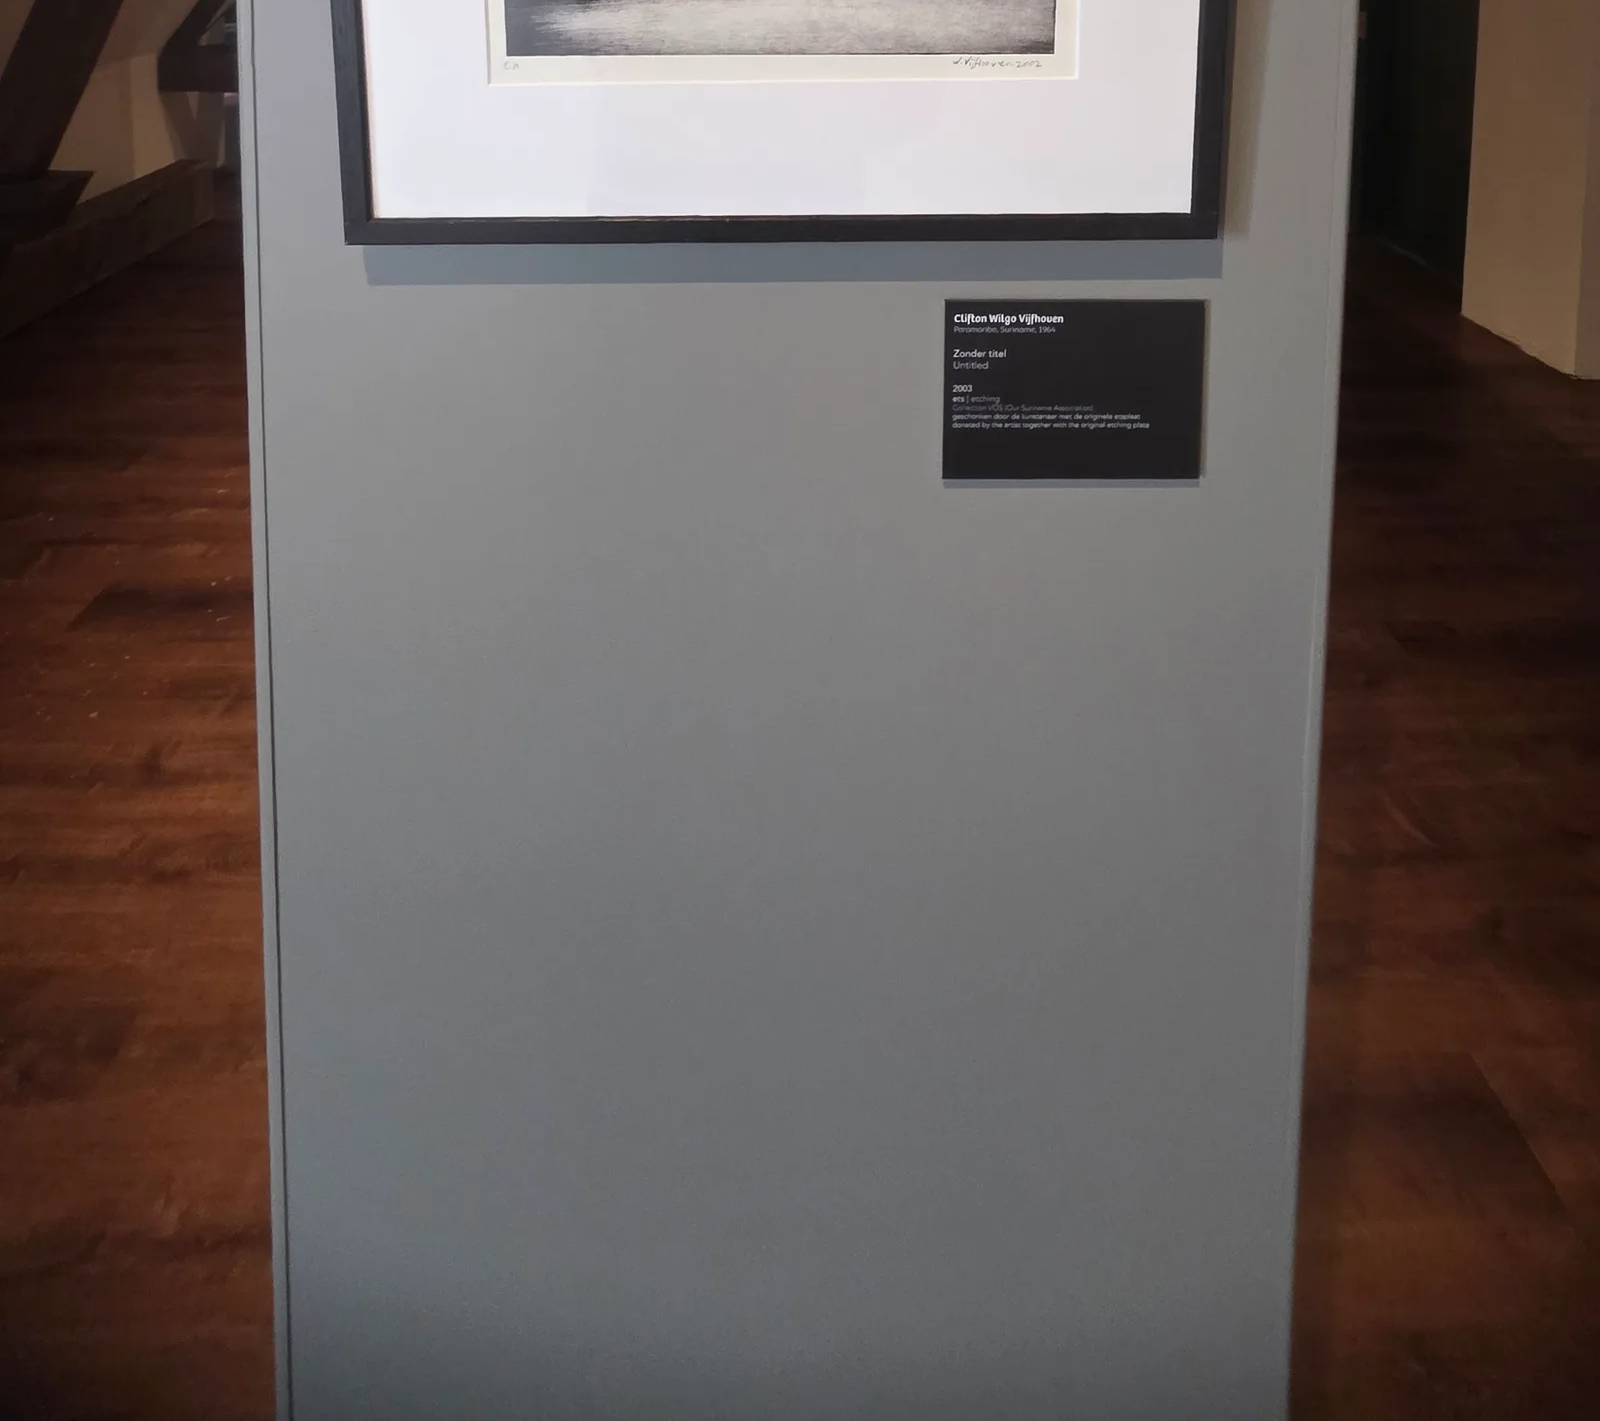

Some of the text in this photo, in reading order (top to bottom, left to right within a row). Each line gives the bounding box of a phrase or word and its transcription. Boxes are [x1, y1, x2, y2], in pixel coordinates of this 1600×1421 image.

[953, 314, 1064, 326] Clifton Wilgo Vijfhoven
[953, 326, 998, 334] Paramoribo,
[1000, 326, 1037, 334] Suriname,
[953, 349, 1007, 358] Zonder titel
[953, 361, 989, 370] Untitled
[952, 384, 973, 393] 2003
[971, 395, 1000, 404] etching
